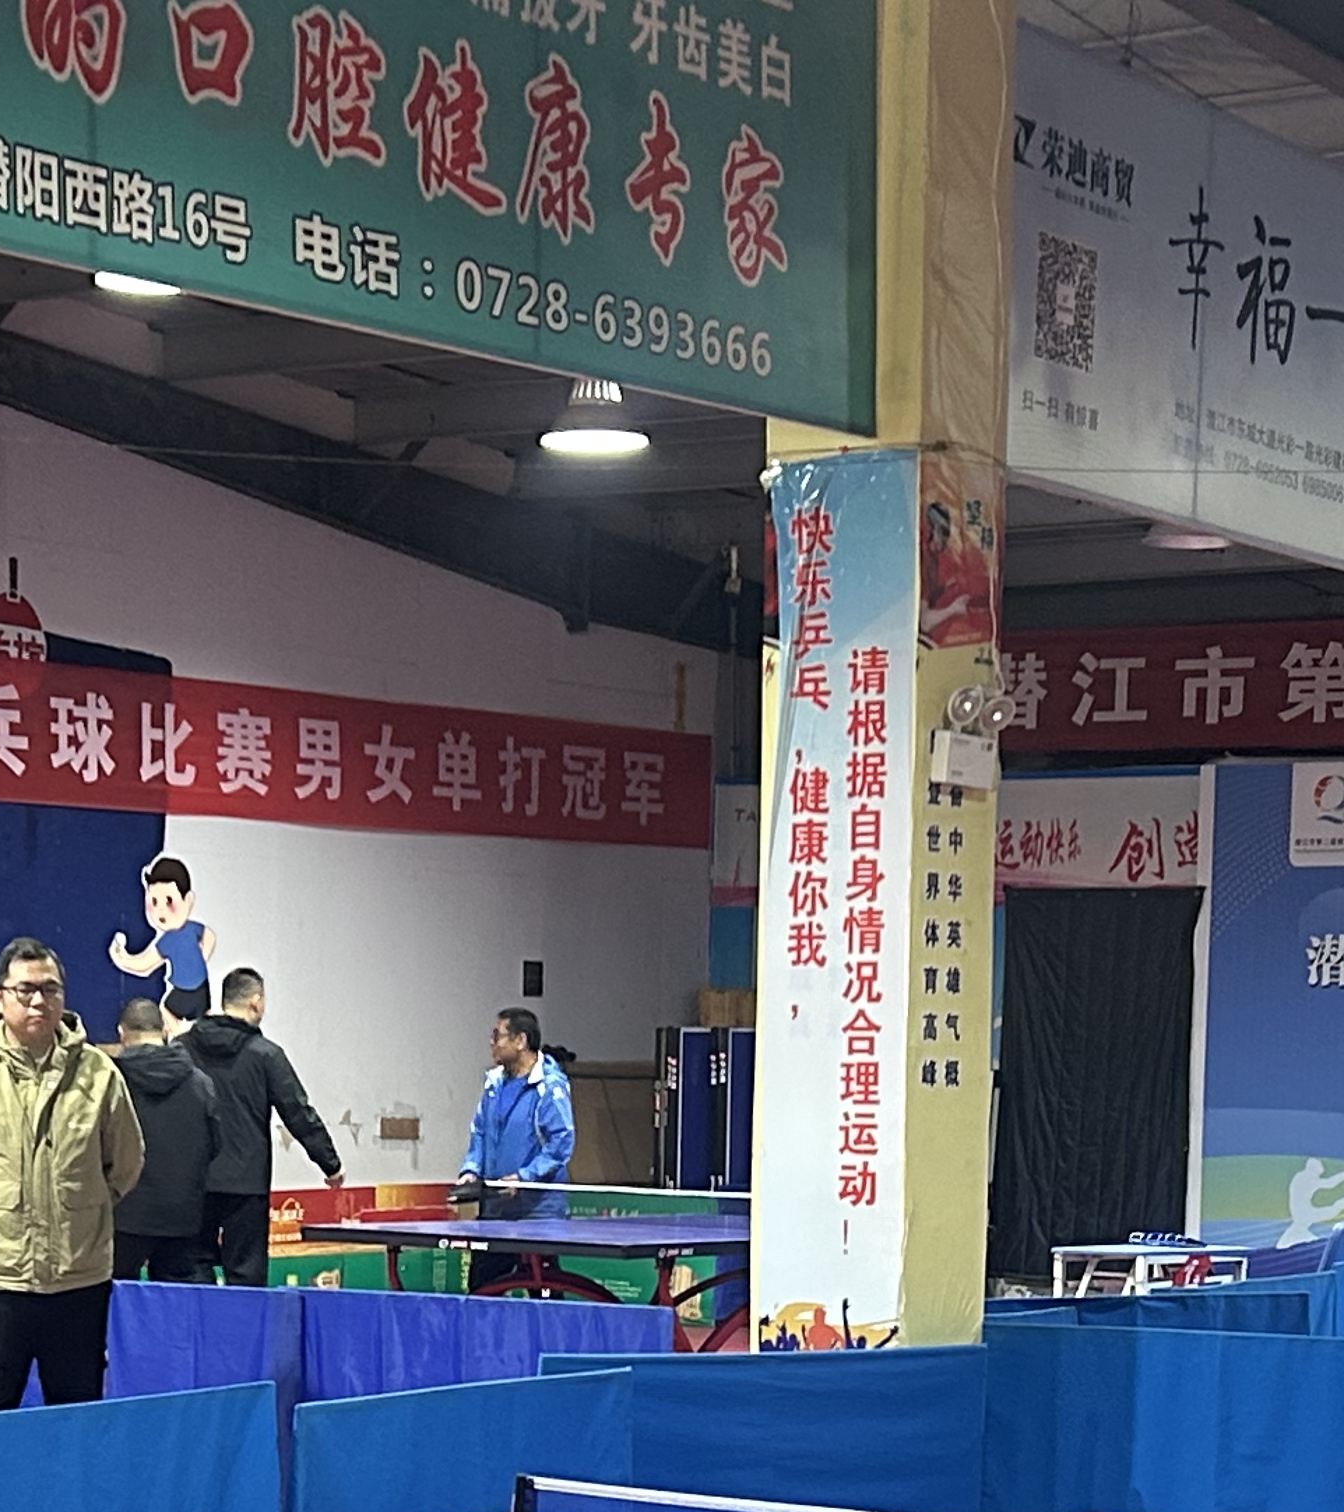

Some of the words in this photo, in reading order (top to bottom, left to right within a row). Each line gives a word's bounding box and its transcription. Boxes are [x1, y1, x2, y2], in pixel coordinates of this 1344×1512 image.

[629, 0, 792, 107] 牙齿美白
[293, 212, 774, 379] 电话：0728-6393666
